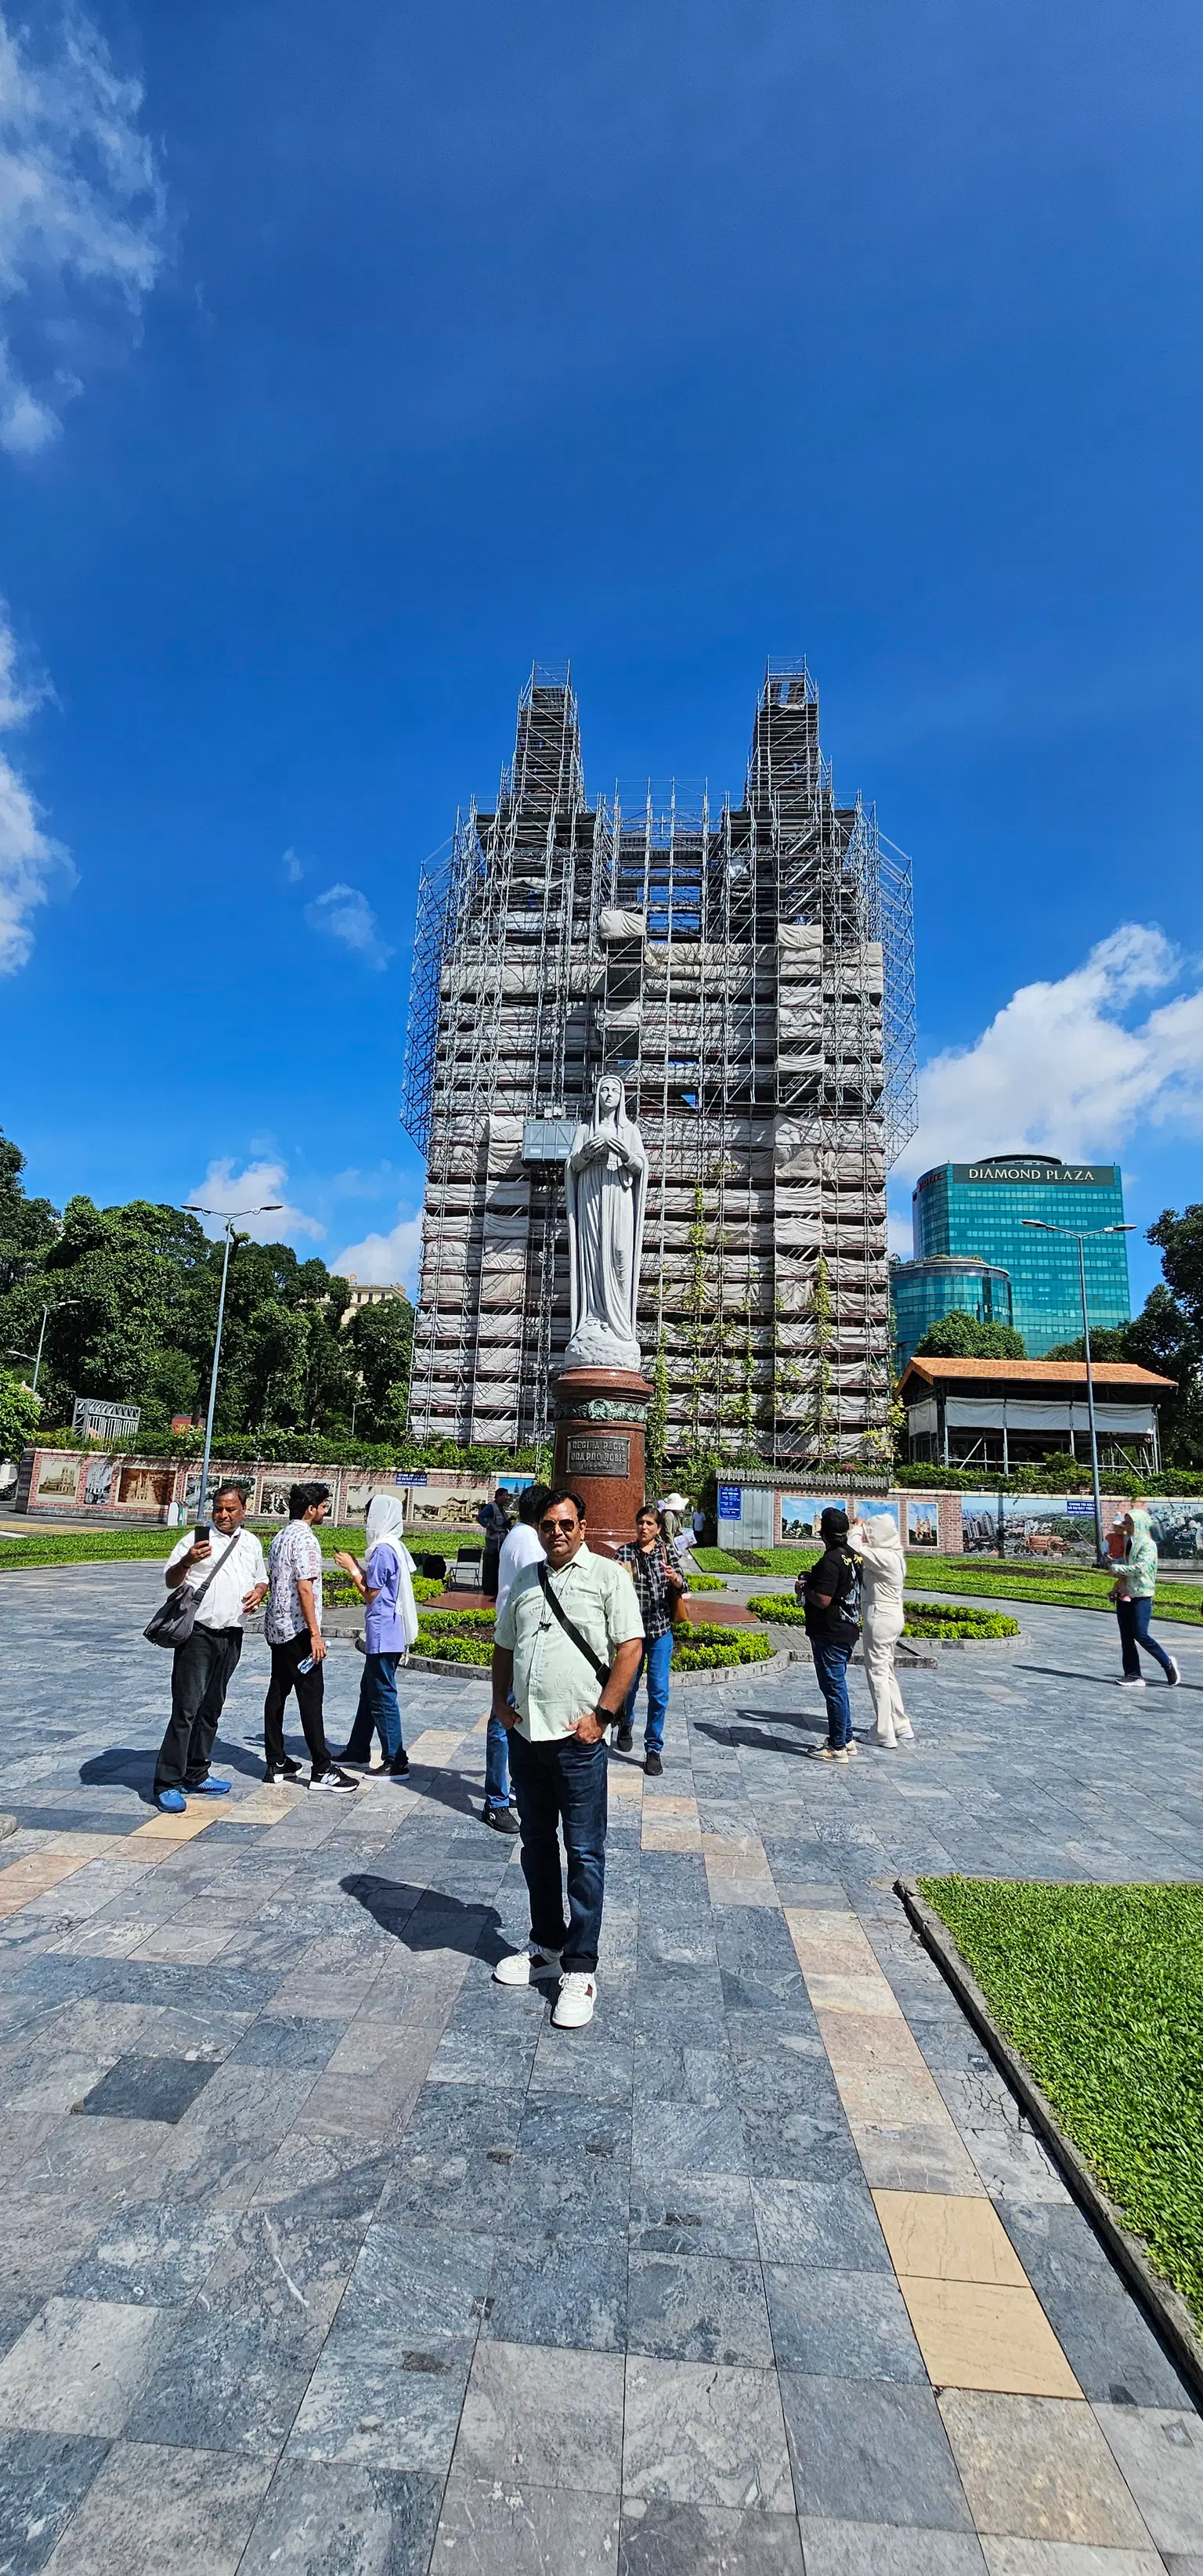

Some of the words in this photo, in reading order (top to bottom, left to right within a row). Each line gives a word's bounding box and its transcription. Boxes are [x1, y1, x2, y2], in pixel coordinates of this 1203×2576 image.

[968, 1168, 1042, 1180] DIAMOND
[1046, 1170, 1096, 1181] PLAZA
[572, 1440, 599, 1451] REGINA
[604, 1453, 626, 1462] NOBIS
